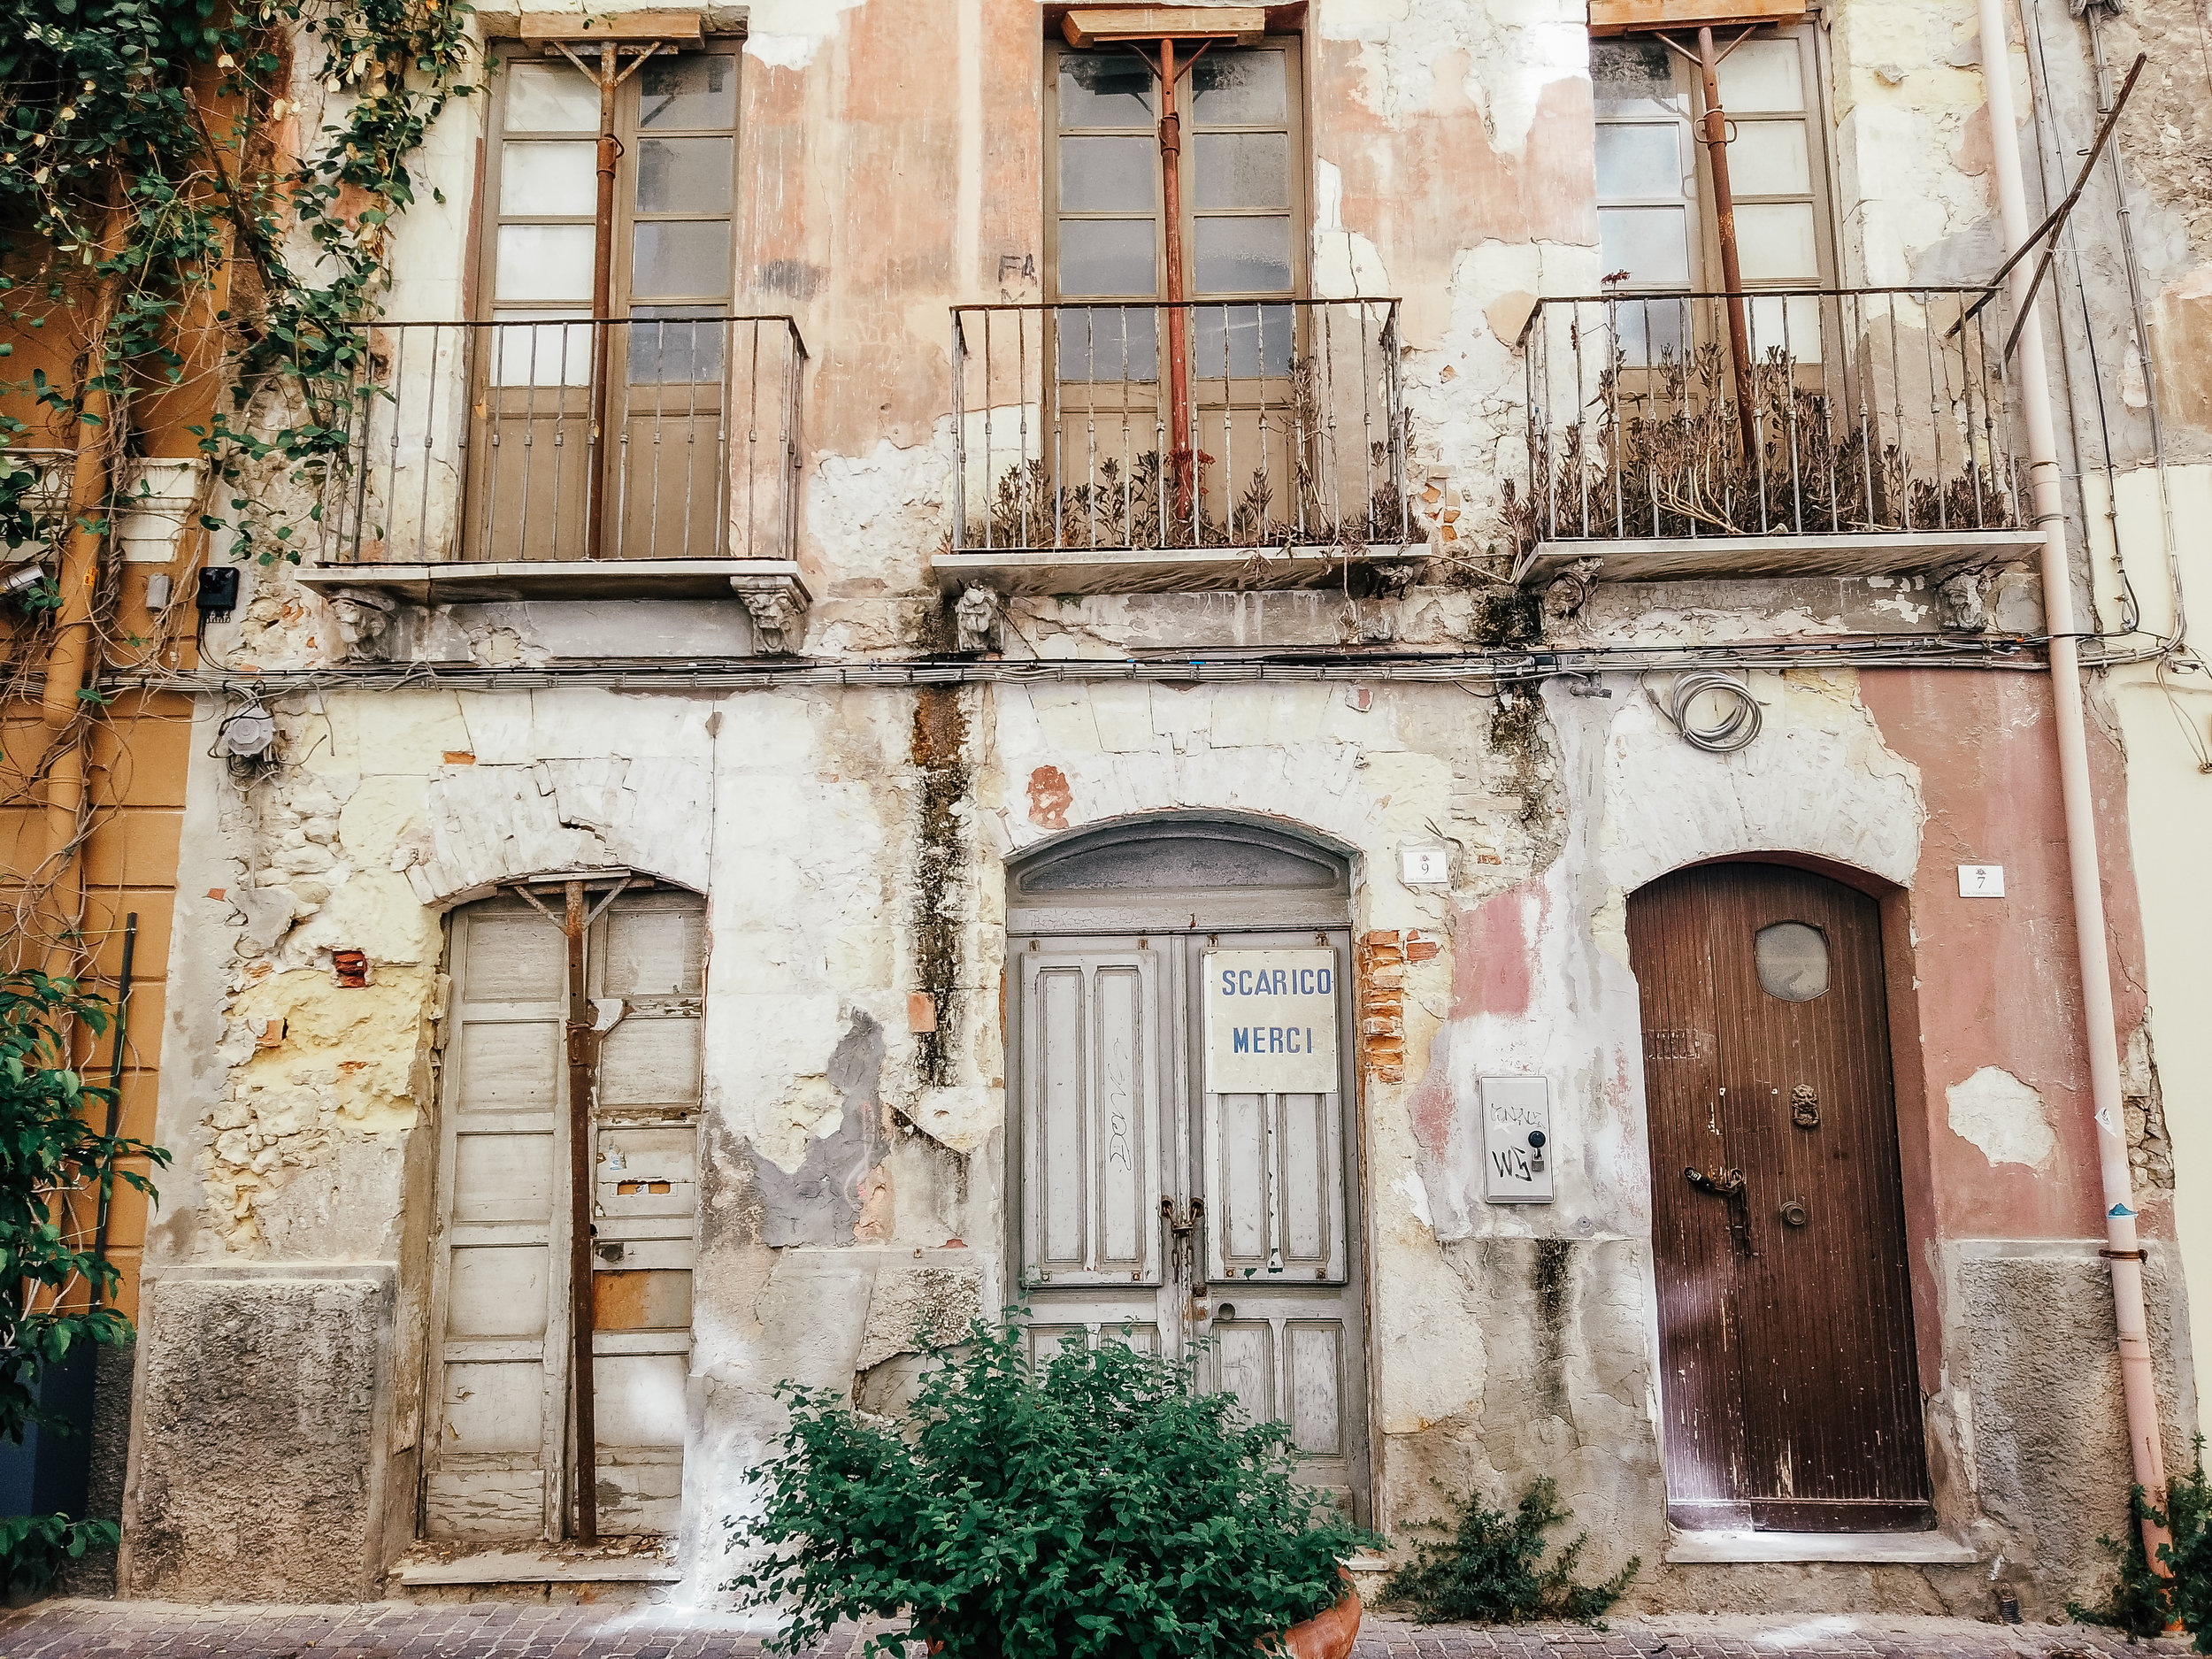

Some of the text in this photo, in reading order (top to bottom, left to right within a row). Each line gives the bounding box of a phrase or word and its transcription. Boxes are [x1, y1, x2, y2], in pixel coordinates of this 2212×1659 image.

[1421, 863, 1429, 875] 9
[1978, 877, 1985, 889] 7
[1222, 969, 1331, 995] SCARICO
[1233, 1027, 1312, 1054] MERCI
